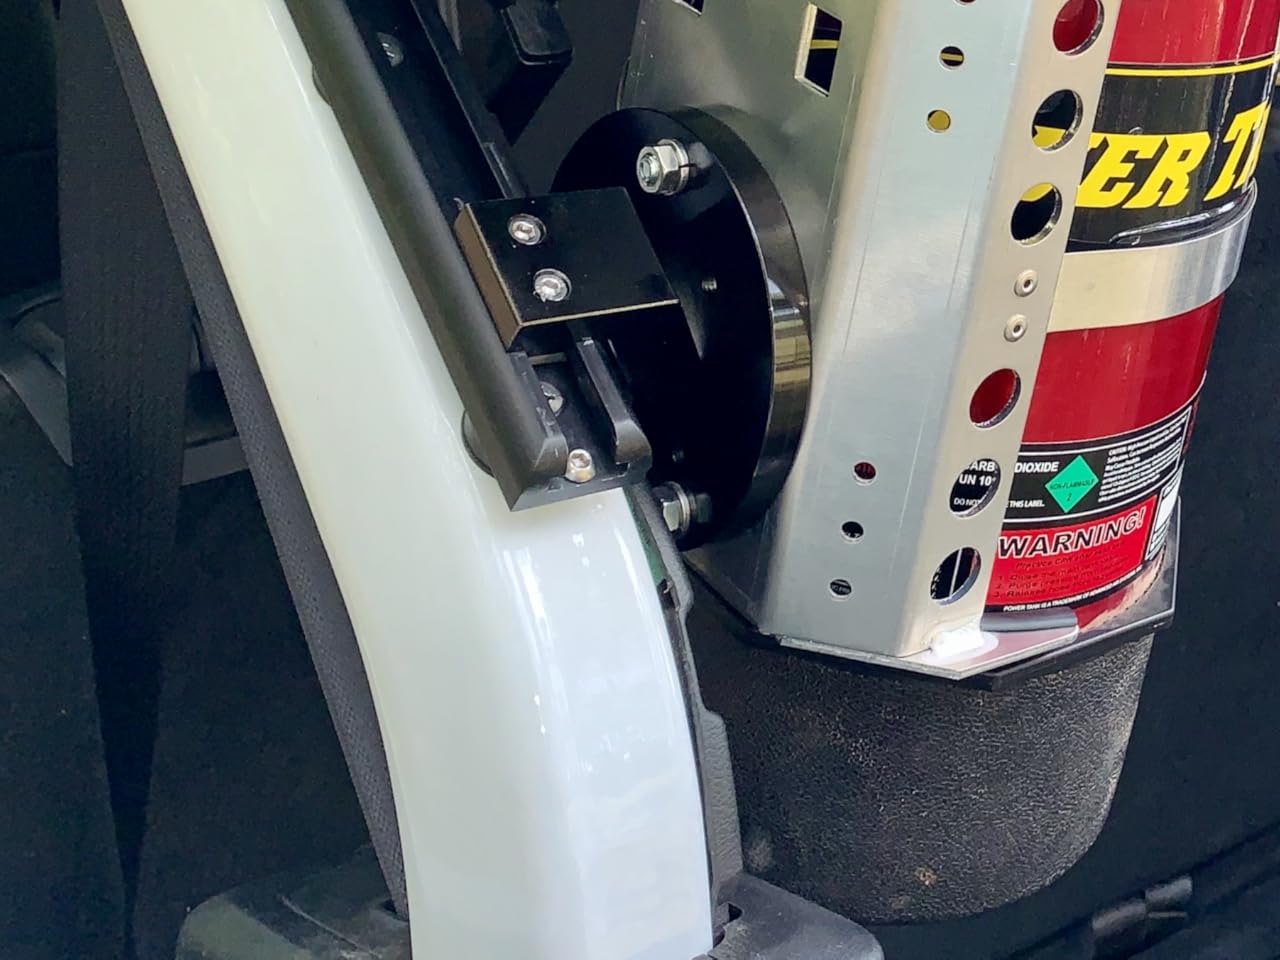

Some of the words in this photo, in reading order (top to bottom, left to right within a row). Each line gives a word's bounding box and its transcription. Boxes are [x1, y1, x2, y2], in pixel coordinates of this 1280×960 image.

[967, 460, 996, 472] ARB
[1014, 461, 1060, 473] DIOXIDE
[959, 474, 976, 485] UN
[998, 506, 1147, 559] WARNING!
